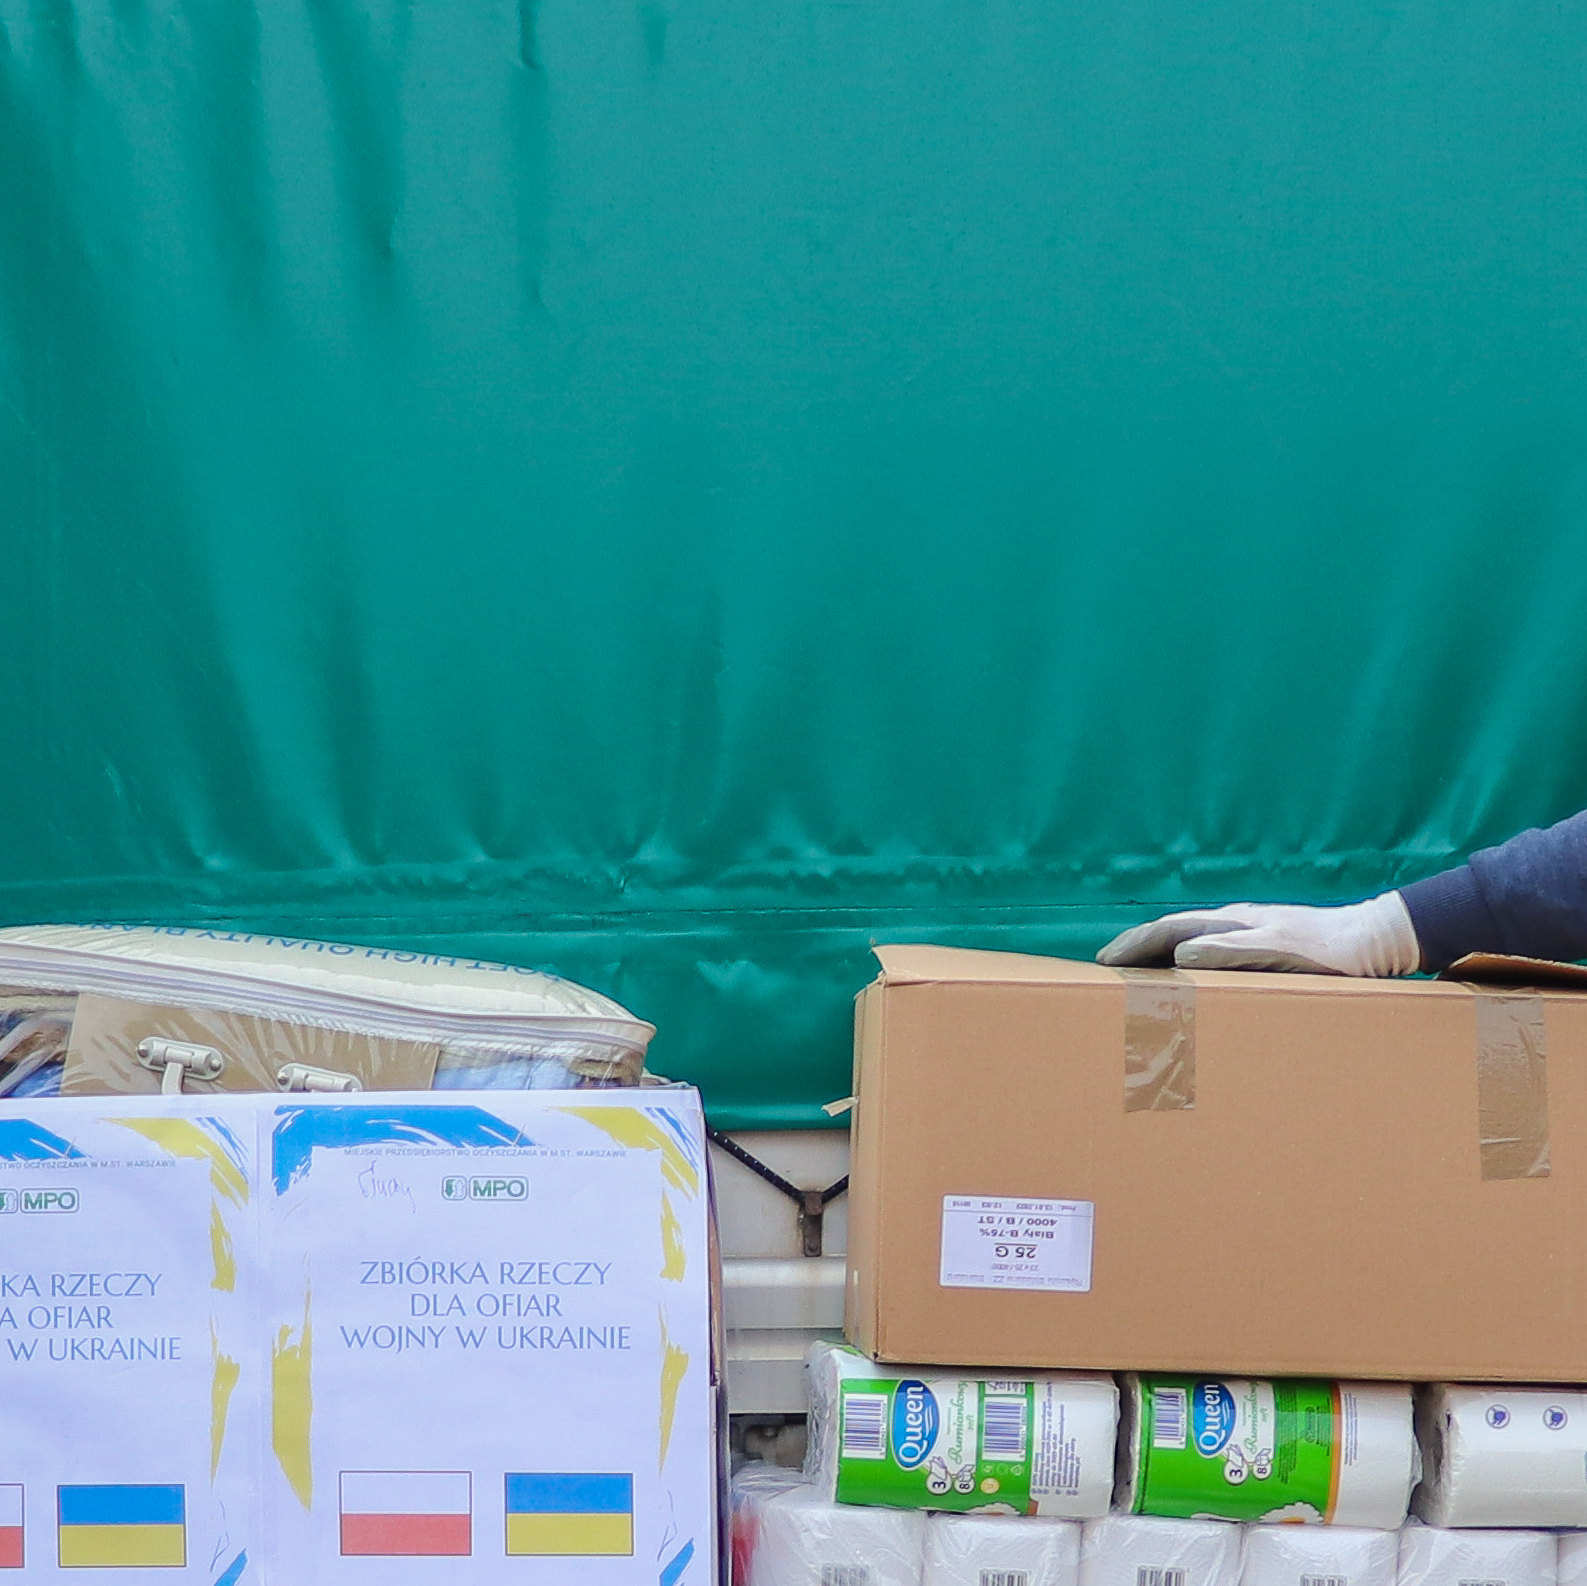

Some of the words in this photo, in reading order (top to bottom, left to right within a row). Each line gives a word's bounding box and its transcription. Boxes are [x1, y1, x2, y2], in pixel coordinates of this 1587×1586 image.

[473, 1180, 525, 1197] MPO
[24, 1192, 75, 1210] MPO
[995, 1245, 1008, 1258] G
[1015, 1246, 1036, 1258] 25
[360, 1256, 490, 1286] ZBIÓRKA
[500, 1261, 612, 1286] RZECZY
[51, 1273, 163, 1297] RZECZY
[27, 1305, 114, 1329] OFIAR
[410, 1293, 467, 1317] DLA
[476, 1293, 564, 1318] OFIAR
[7, 1338, 39, 1362] W
[49, 1336, 182, 1361] UKRAINIE
[340, 1324, 447, 1354] WOJNY
[456, 1325, 488, 1350] W
[498, 1325, 631, 1350] UKRAINIE
[899, 1385, 928, 1463] Queen
[1199, 1384, 1225, 1452] Queen
[1230, 1468, 1243, 1477] 3
[932, 1481, 946, 1489] 3
